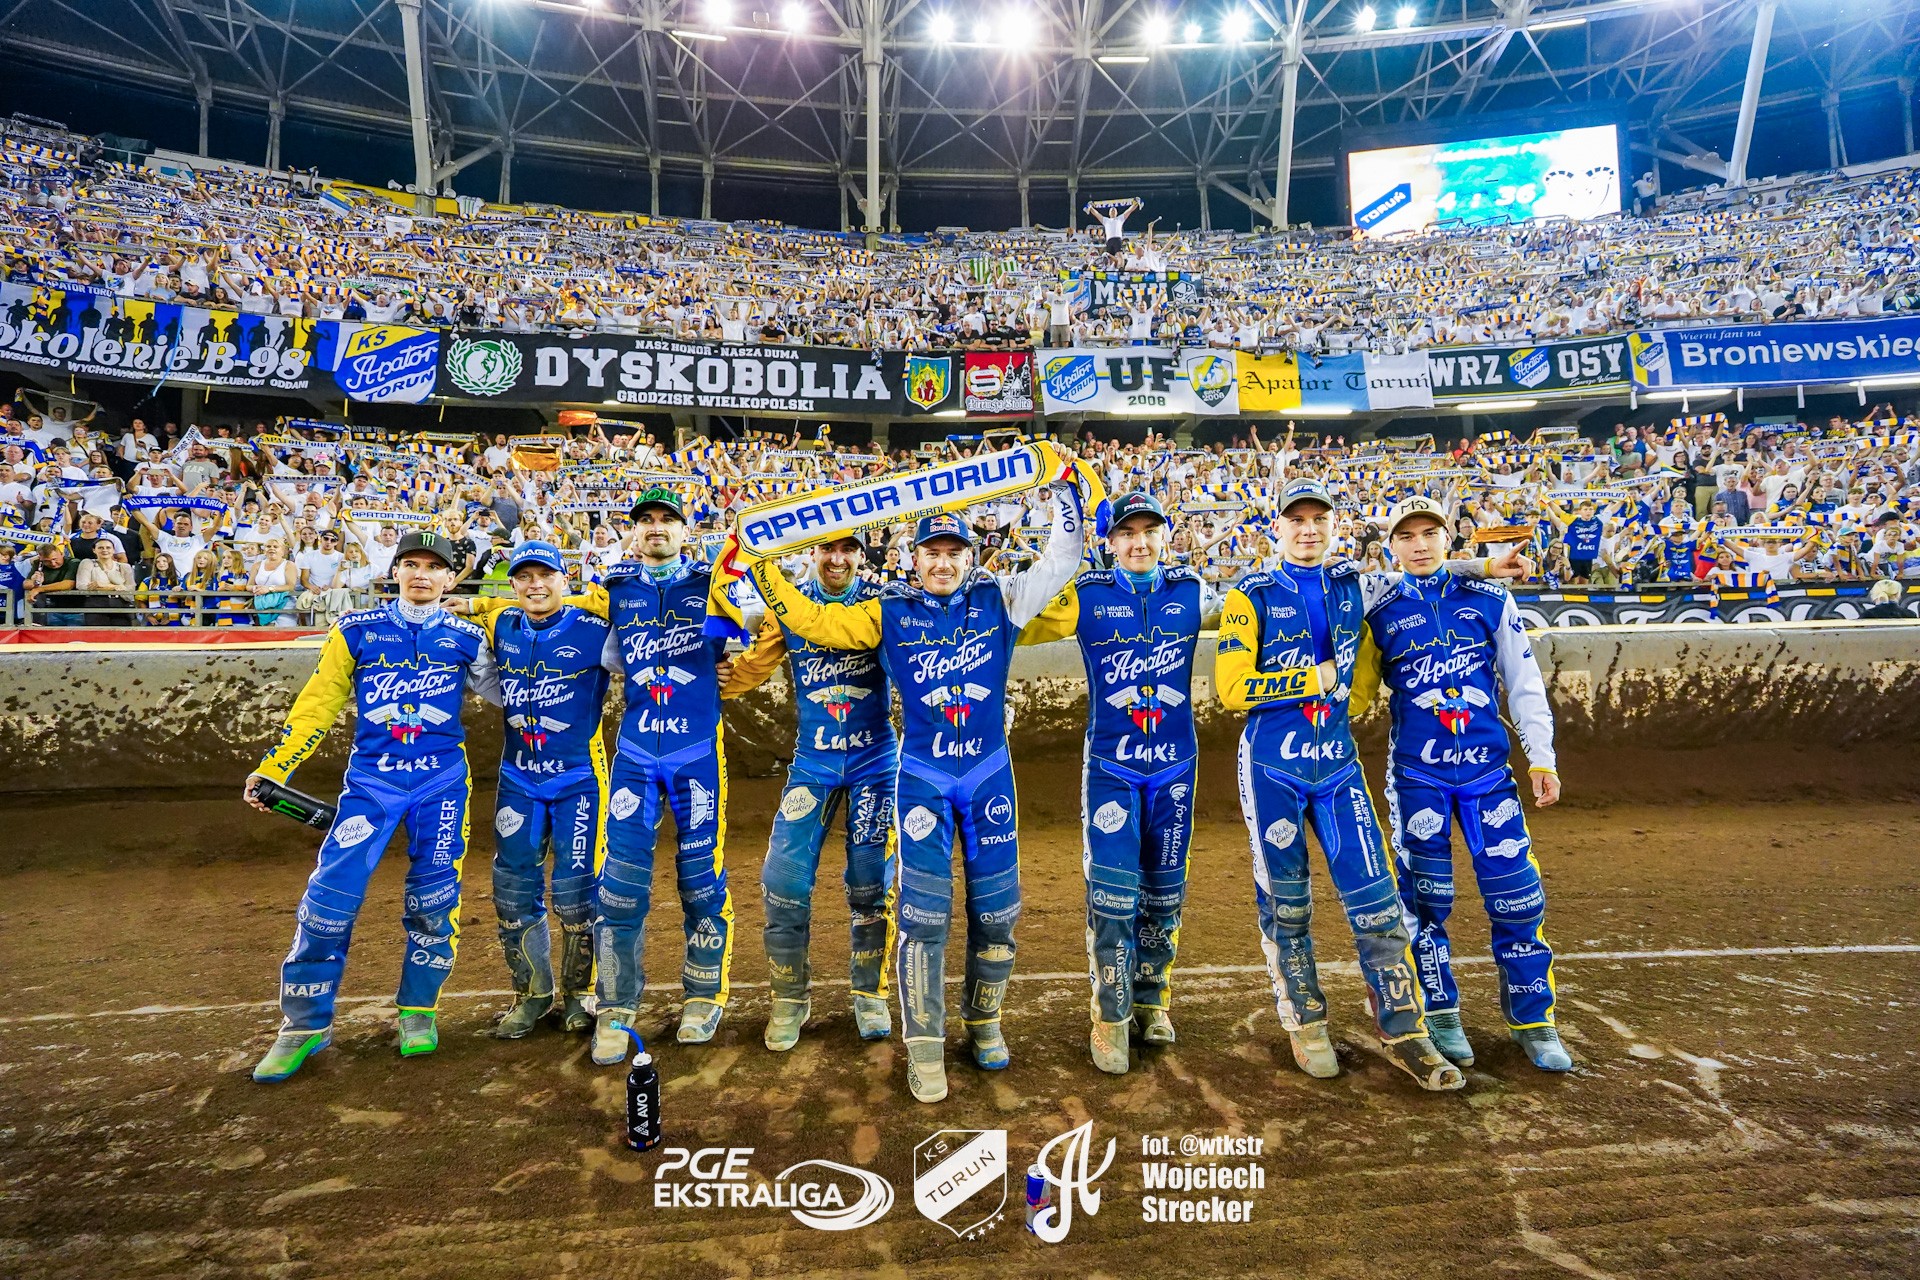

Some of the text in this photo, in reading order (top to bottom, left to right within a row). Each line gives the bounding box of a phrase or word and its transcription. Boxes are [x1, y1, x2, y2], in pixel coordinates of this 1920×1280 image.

[1361, 191, 1407, 224] TORUŃ
[357, 330, 388, 351] KS
[1678, 329, 1762, 342] Wierni fani na
[635, 340, 800, 360] NASZ HONOR NASZA DUMA
[1512, 351, 1523, 363] KS
[1681, 333, 1920, 368] Broniewskie
[198, 340, 306, 380] B-98
[345, 340, 440, 389] Apator
[1429, 342, 1624, 388] WRZ OSY
[1514, 349, 1545, 380] Apator
[534, 347, 892, 401] DYSKOBOLIA
[1049, 362, 1062, 377] KS
[1052, 358, 1093, 396] Apator
[1105, 356, 1180, 393] UF
[215, 375, 265, 387] KLUBOWI
[270, 378, 309, 390] ODDANI
[1238, 371, 1431, 395] Apator Toruń
[617, 389, 815, 412] GRODZISK WIELKOPOLSKI
[1128, 395, 1166, 407] 2008
[1202, 391, 1225, 402] 2008
[126, 496, 197, 506] KLUB SPORTOWY
[743, 449, 1033, 546] APATOR TORUŃ
[1123, 501, 1154, 512] PRES
[351, 511, 395, 520] APATOR
[851, 506, 944, 535] ZAWSZE WIERNI
[1060, 500, 1076, 533] AVO
[513, 549, 555, 561] MAGIK
[1075, 573, 1112, 585] CANAL+
[1239, 574, 1270, 591] CANAL+
[1466, 580, 1503, 596] APRO
[1165, 607, 1181, 615] PGE
[1398, 613, 1422, 625] MIASTO
[338, 611, 387, 628] CANAL+
[1226, 613, 1249, 626] AVO
[439, 641, 456, 649] PGE
[626, 624, 704, 664] Apator
[914, 631, 991, 684] Apator
[1101, 637, 1187, 684] KS Apator
[1401, 641, 1486, 688] KS Apator
[363, 665, 458, 704] KS Apator
[502, 675, 575, 707] Apator
[1244, 671, 1307, 695] TMC
[638, 709, 680, 734] Lux
[814, 725, 865, 751] Lux
[932, 732, 978, 758] Lux
[1280, 731, 1335, 761] Lux
[1116, 735, 1169, 763] Lux
[1420, 738, 1479, 765] Lux
[377, 752, 429, 773] Lux
[515, 750, 555, 774] Lux
[613, 795, 630, 807] Polski
[615, 801, 637, 814] Cukier
[785, 794, 808, 808] Polski
[786, 802, 812, 815] Cukier
[907, 813, 928, 827] Polski
[1097, 809, 1119, 823] Polski
[1102, 815, 1124, 829] Cukier
[1411, 815, 1434, 831] Polski
[339, 822, 365, 836] Polski
[436, 799, 457, 851] REXER
[912, 821, 936, 835] Cukier
[1169, 799, 1188, 867] for Nature
[1268, 825, 1290, 838] Polski
[1419, 821, 1441, 836] Cukier
[341, 831, 369, 843] Cukier
[572, 809, 588, 870] MAGIK
[681, 836, 713, 851] furnisol
[981, 830, 1017, 845] STALCO
[1276, 831, 1296, 843] Cukier
[1161, 828, 1171, 866] Solutions
[421, 898, 439, 908] AUTO
[767, 898, 780, 907] AUTO
[1105, 900, 1120, 908] AUTO
[1510, 904, 1527, 912] AUTO
[307, 921, 325, 931] AUTO
[912, 915, 928, 924] AUTO
[688, 933, 723, 949] AVO
[1437, 945, 1449, 964] BIS
[1502, 951, 1518, 959] HAS
[981, 986, 1001, 997] MU
[1508, 981, 1547, 994] BETPOL
[907, 989, 916, 1009] Jörg
[979, 998, 998, 1008] RA
[637, 1093, 649, 1118] AVO
